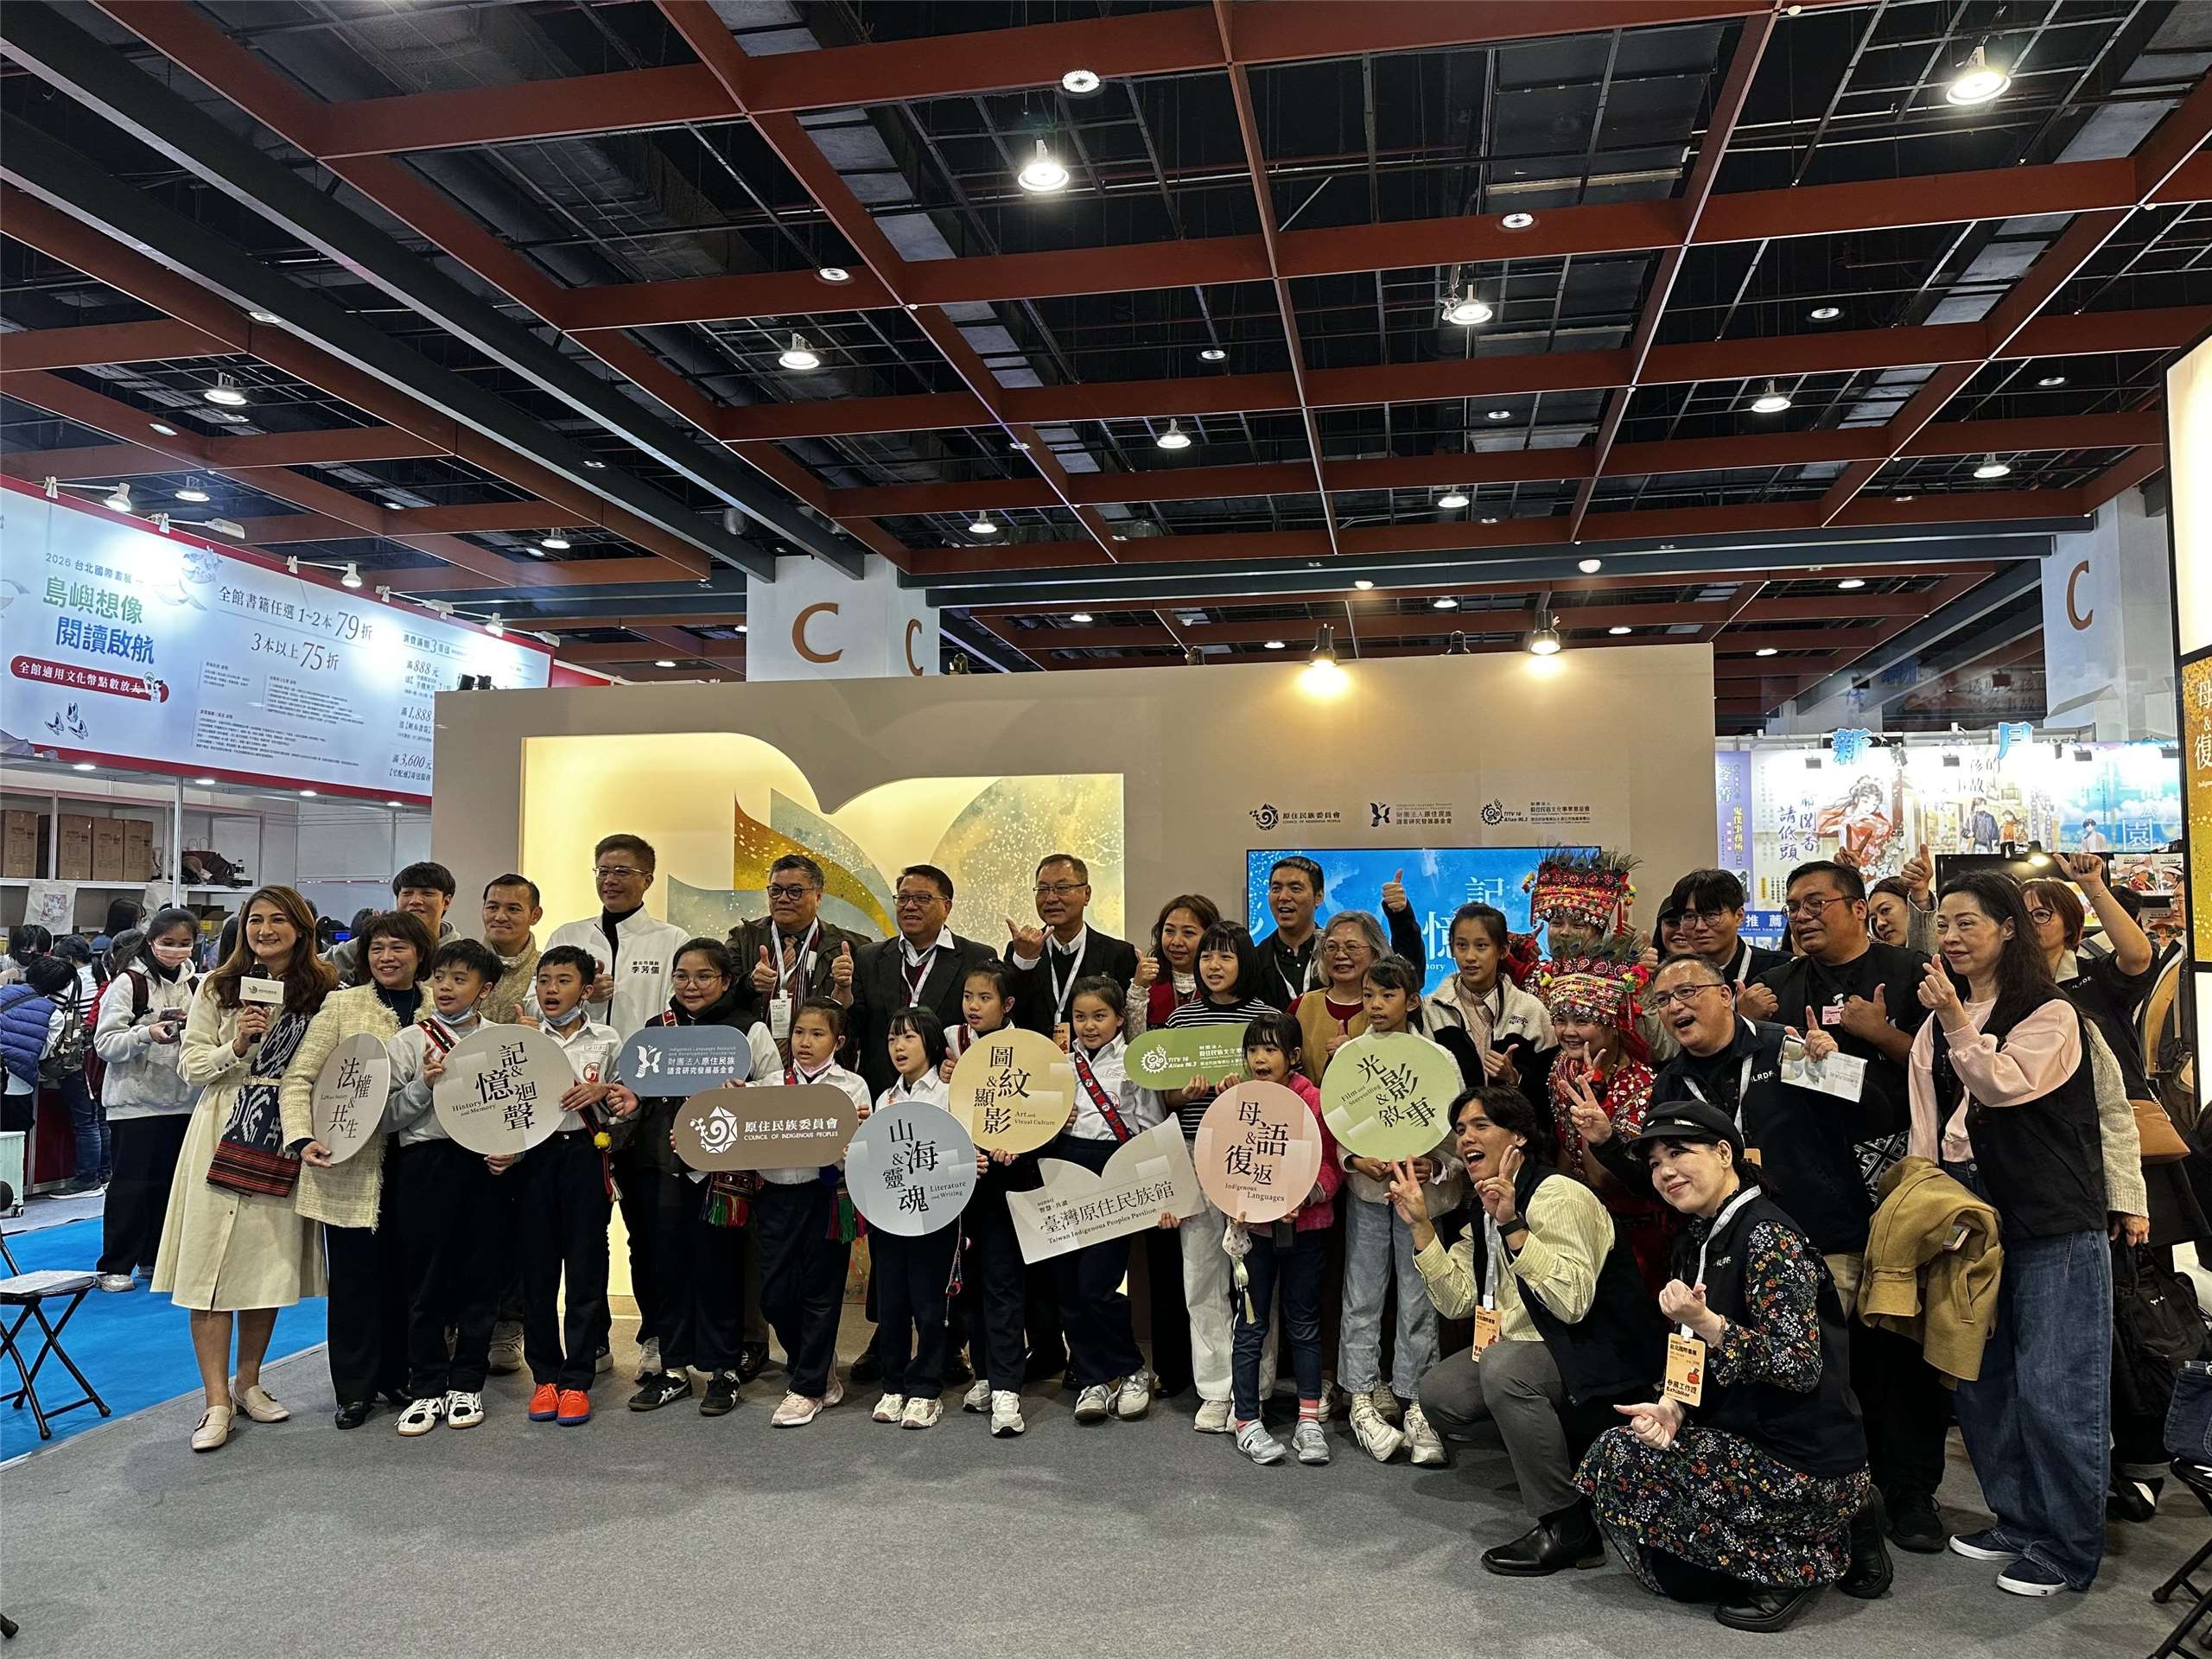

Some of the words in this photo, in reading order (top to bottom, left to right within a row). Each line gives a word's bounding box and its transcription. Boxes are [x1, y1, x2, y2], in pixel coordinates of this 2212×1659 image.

[46, 552, 71, 567] 2026
[43, 576, 143, 624] 島嶼想像
[2066, 560, 2093, 631] C
[55, 616, 154, 664] 閱讀啟航
[792, 602, 843, 664] C
[906, 619, 923, 676] C
[1778, 805, 1800, 861] 請低頭
[668, 1056, 735, 1065] 財團法人原住民族
[667, 1065, 734, 1075] 語言研究發展基金會
[1341, 1090, 1357, 1103] Film
[452, 1100, 482, 1112] History
[470, 1103, 496, 1114] Memory
[745, 1117, 838, 1133] 原住民族委員會
[930, 1181, 967, 1192] Literature
[1225, 1183, 1257, 1192] Indigenous
[940, 1190, 963, 1199] Writing
[1247, 1192, 1285, 1202] Languages
[1039, 1180, 1174, 1235] 臺灣原住民族館
[1048, 1234, 1071, 1244] Taiwan
[1071, 1224, 1105, 1237] Indigenous
[1106, 1215, 1130, 1227] Peoples
[1131, 1208, 1157, 1219] Pavilion
